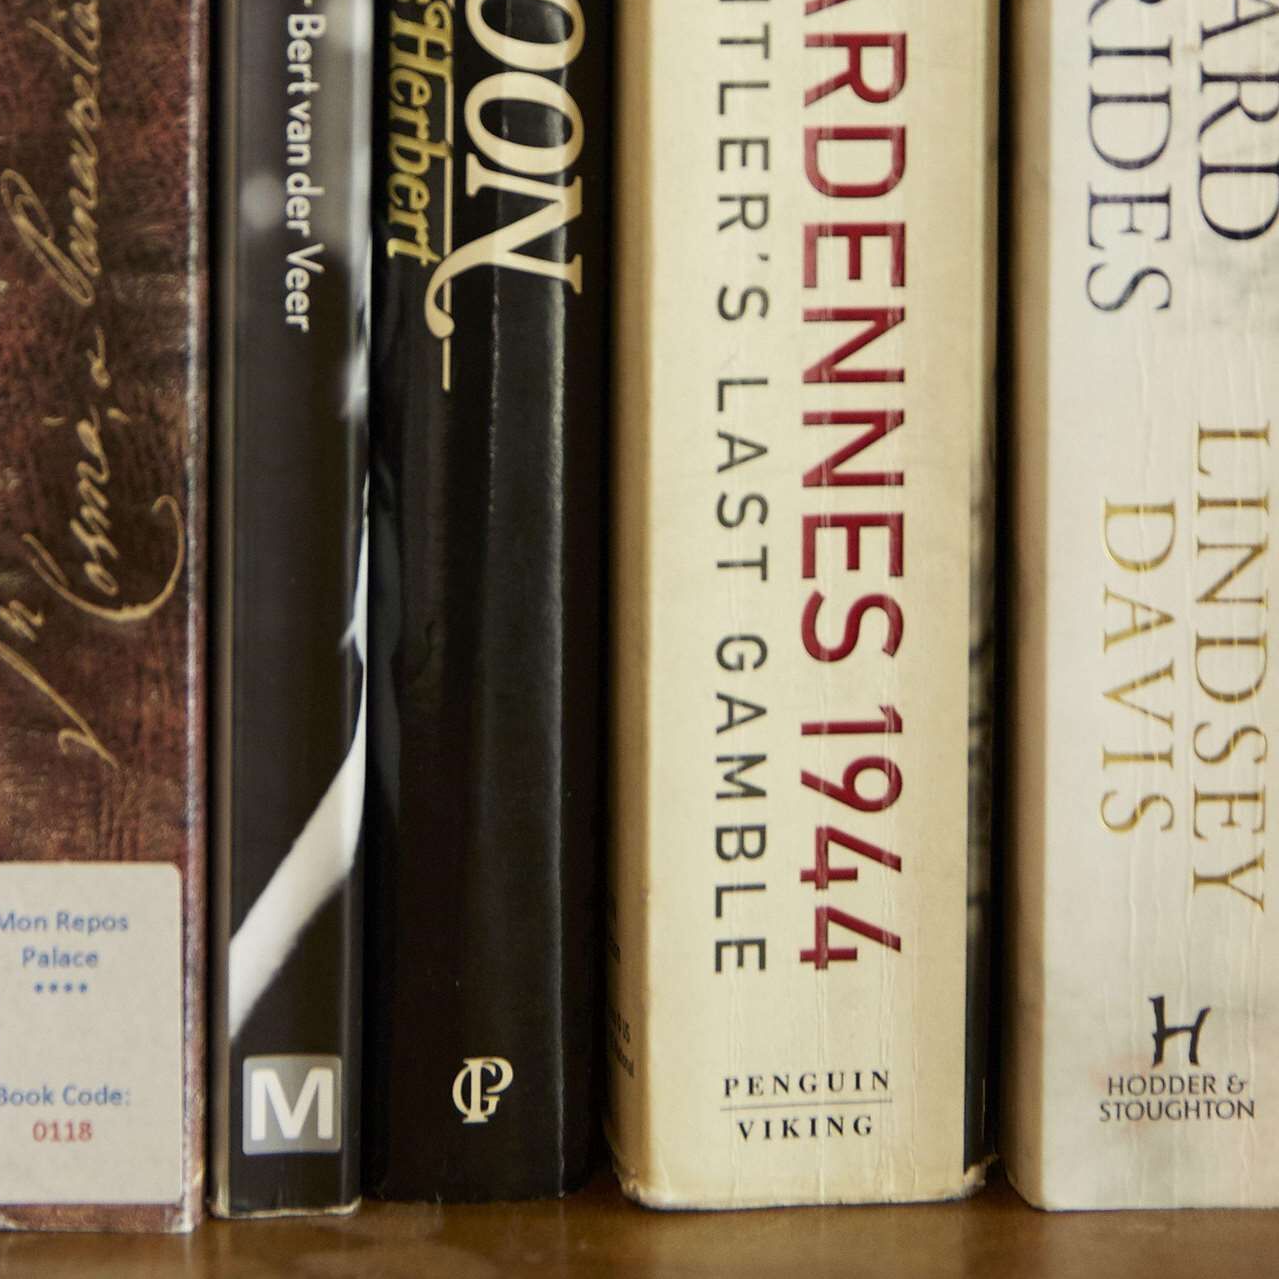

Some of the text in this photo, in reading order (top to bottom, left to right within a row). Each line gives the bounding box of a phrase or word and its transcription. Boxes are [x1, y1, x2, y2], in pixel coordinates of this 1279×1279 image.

[286, 13, 327, 95] Bert
[286, 100, 312, 166] van
[387, 1, 454, 267] Herbert
[285, 171, 325, 238] der
[285, 242, 325, 333] Veer
[715, 377, 769, 581] LAST
[1100, 496, 1177, 834] DAVIS
[1192, 420, 1271, 914] LINDSEY
[714, 634, 768, 974] GAMBLE
[799, 705, 904, 971] 1944
[22, 947, 99, 968] Palace
[56, 912, 129, 936] Repos
[63, 1085, 131, 1107] Code:
[251, 1067, 334, 1141] M
[723, 1068, 891, 1098] PENGUIN
[1099, 1100, 1256, 1122] STOUGHTON
[1107, 1074, 1248, 1097] HODDER &
[32, 1121, 93, 1143] 0118
[737, 1114, 874, 1141] VIKING
